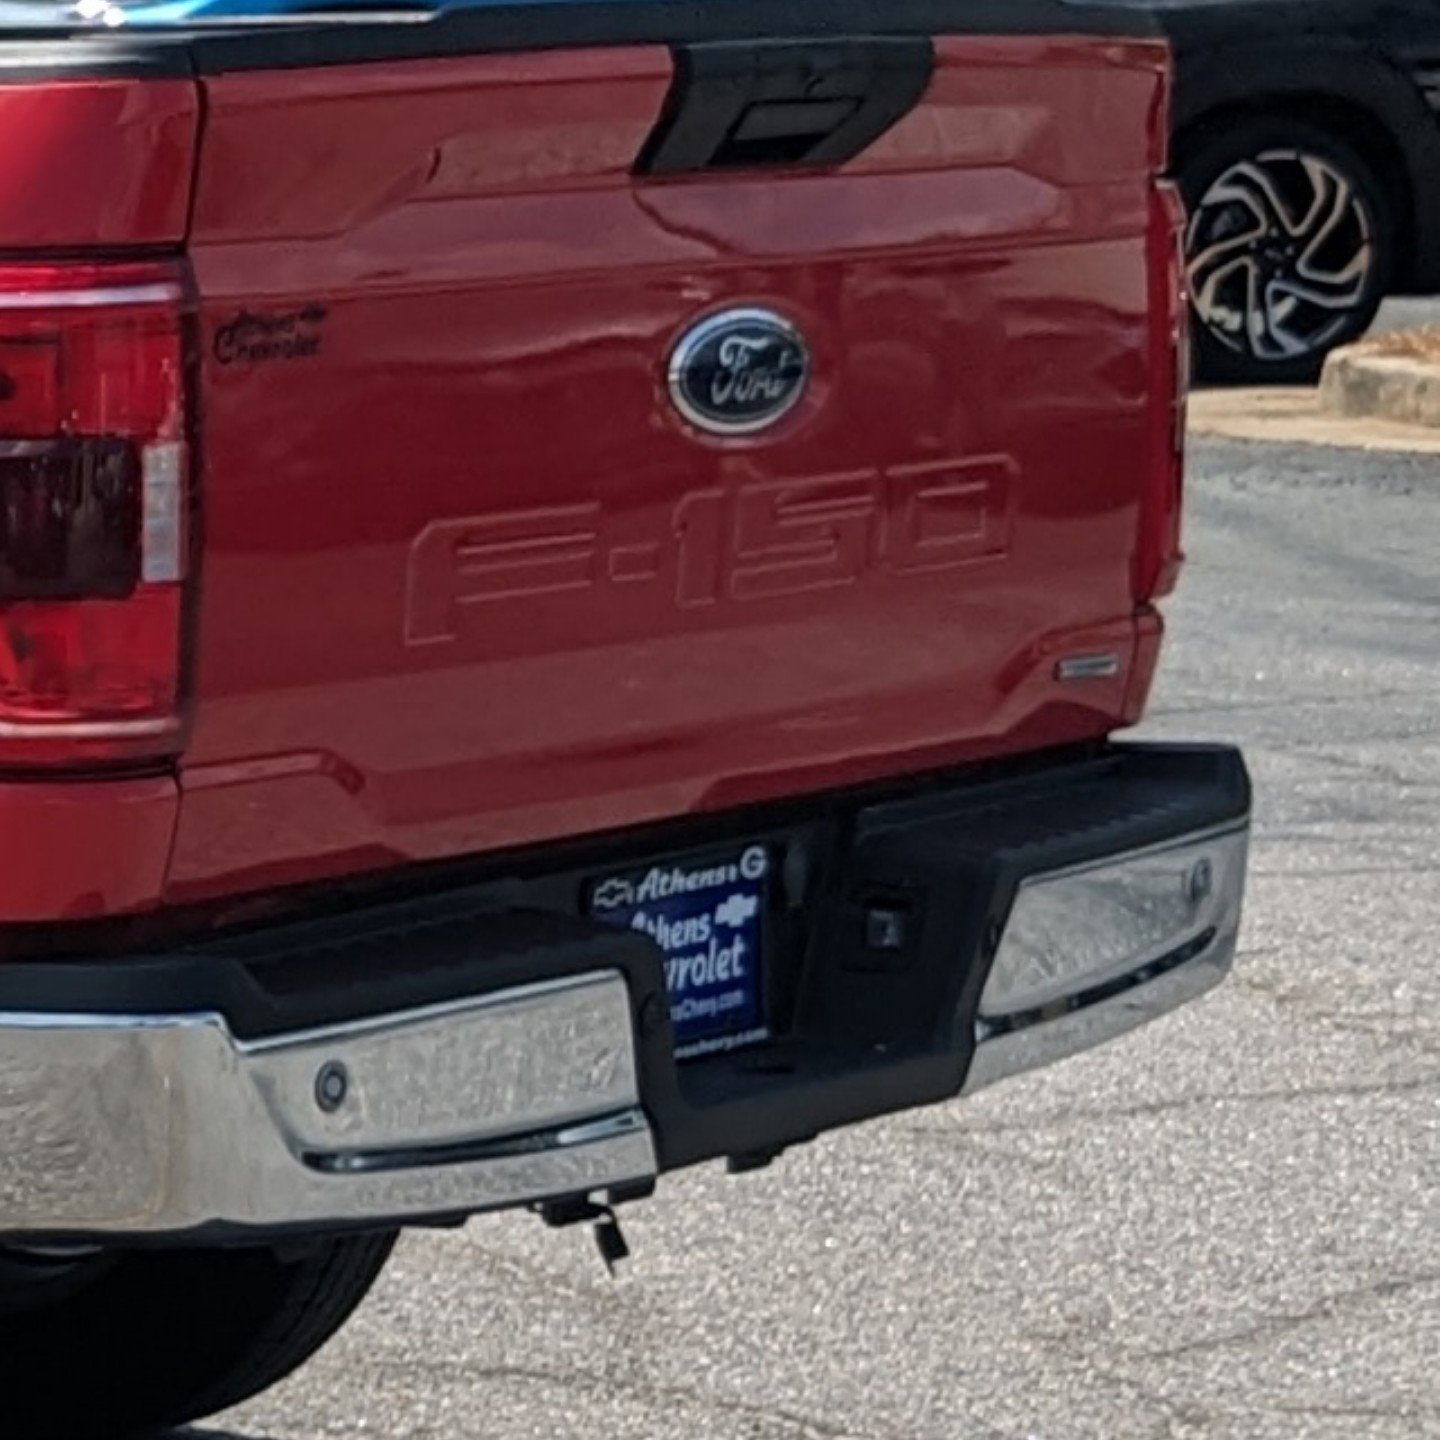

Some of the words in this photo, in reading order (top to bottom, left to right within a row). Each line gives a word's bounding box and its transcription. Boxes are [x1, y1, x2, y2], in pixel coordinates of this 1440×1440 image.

[710, 334, 796, 406] Ford
[404, 451, 1021, 648] F-150
[635, 866, 726, 904] Athens
[662, 933, 746, 992] vrolet
